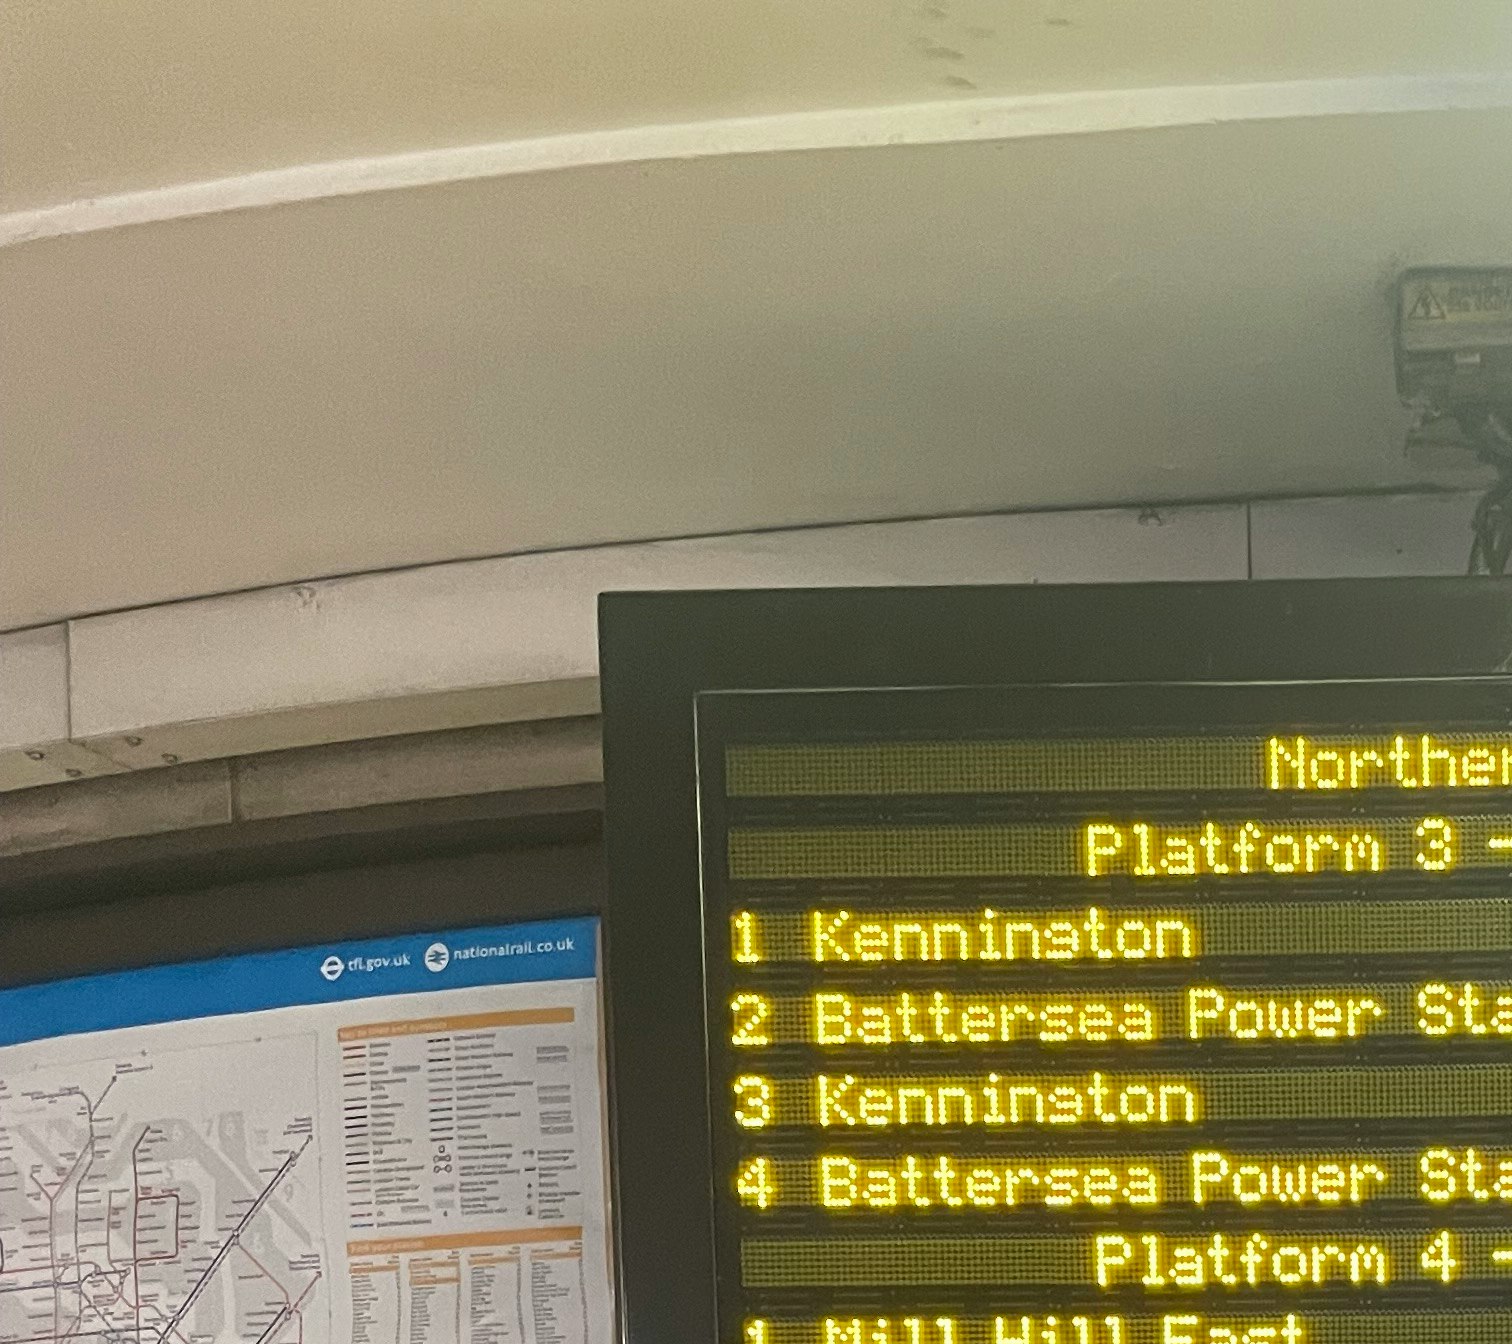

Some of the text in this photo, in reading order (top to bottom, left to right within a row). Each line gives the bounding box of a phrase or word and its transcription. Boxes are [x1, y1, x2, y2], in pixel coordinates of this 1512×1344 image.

[1086, 821, 1381, 878] Platform
[1414, 817, 1453, 872] 3
[348, 953, 411, 972] tfl.gov.uk
[453, 937, 575, 960] nationalrail.co.uk
[734, 910, 763, 964] 1
[812, 906, 1193, 963] Kennington
[729, 993, 770, 1047] 2
[814, 990, 1155, 1046] Battersea
[1187, 987, 1383, 1040] Power
[732, 1074, 773, 1129] 3
[816, 1070, 1196, 1128] Kennington
[736, 1156, 775, 1210] 4
[820, 1154, 1159, 1208] Battersea
[1190, 1151, 1386, 1205] Power
[1094, 1231, 1387, 1288] Platform
[1420, 1229, 1458, 1283] 4
